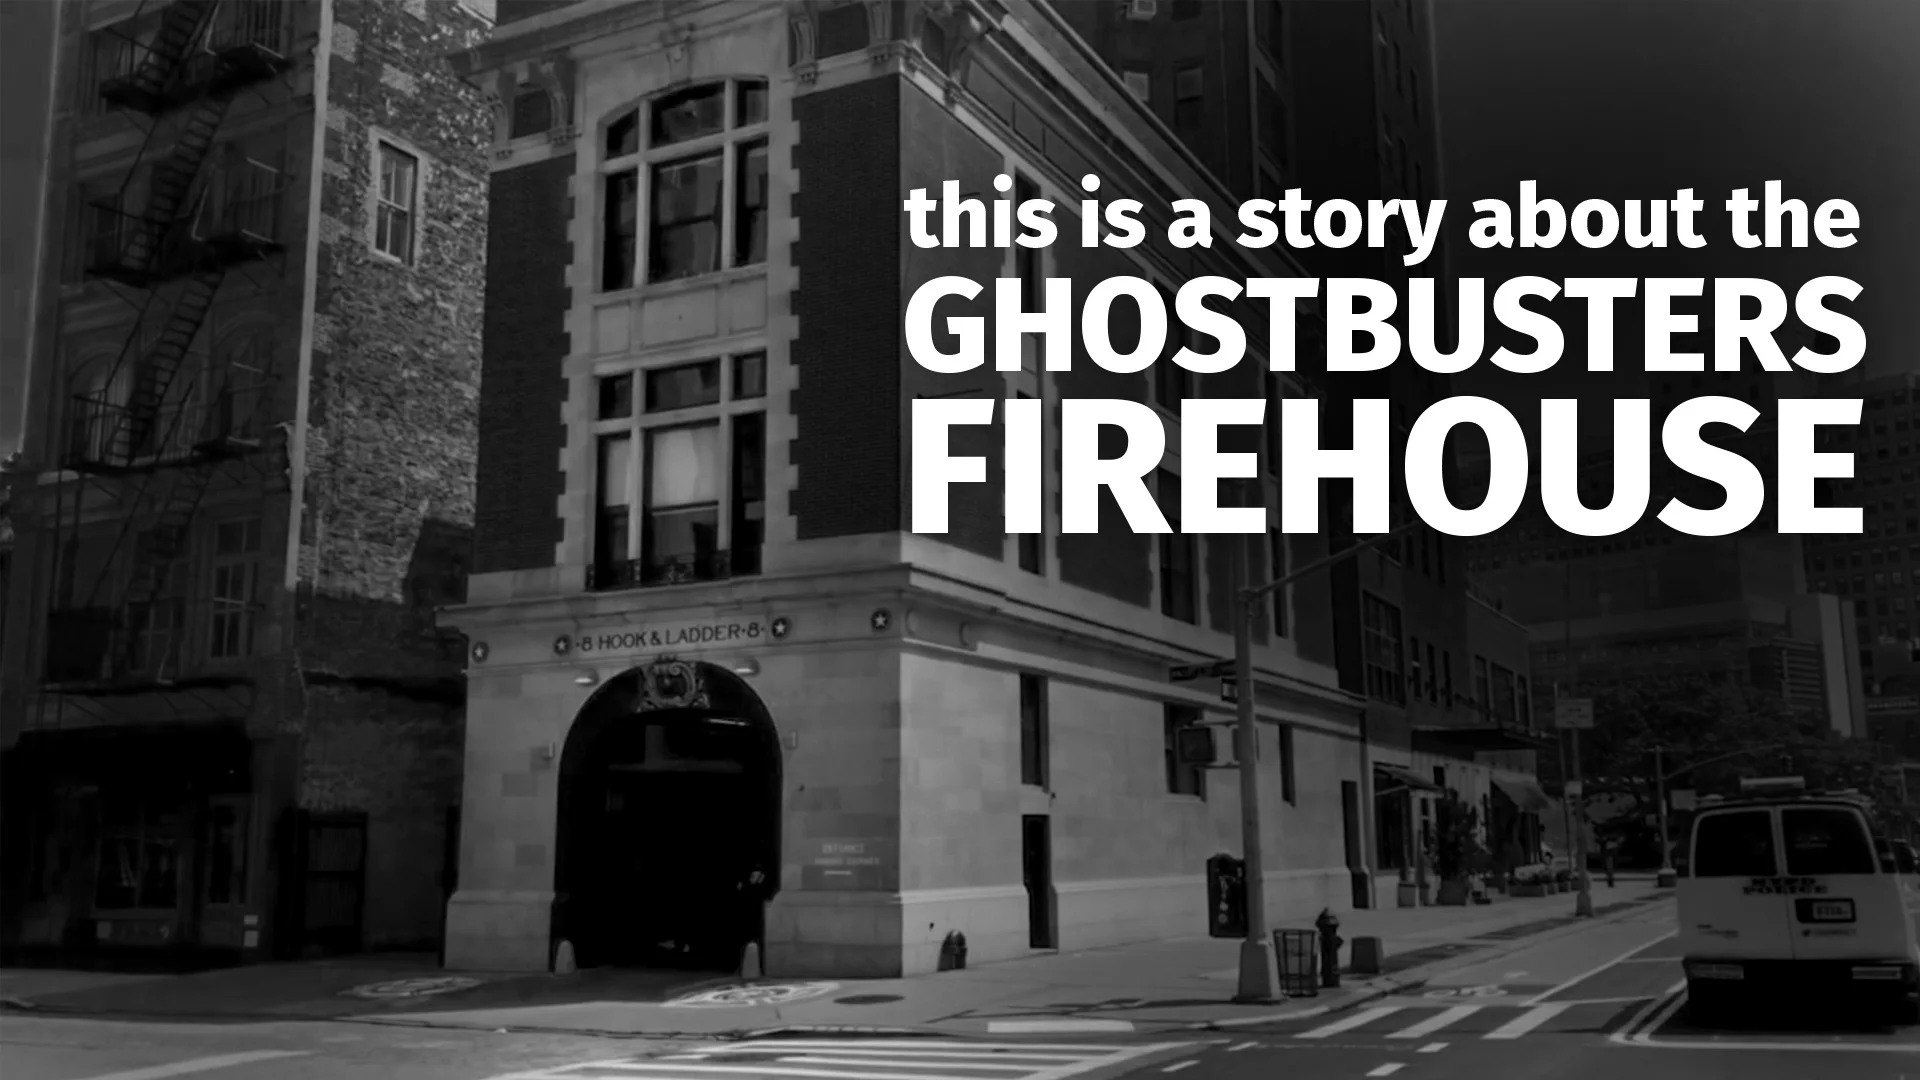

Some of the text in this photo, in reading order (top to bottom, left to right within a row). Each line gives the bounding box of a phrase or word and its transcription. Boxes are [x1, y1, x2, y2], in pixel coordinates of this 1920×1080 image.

[598, 631, 648, 650] HOOK
[650, 630, 662, 645] &
[665, 624, 741, 645] LADDER
